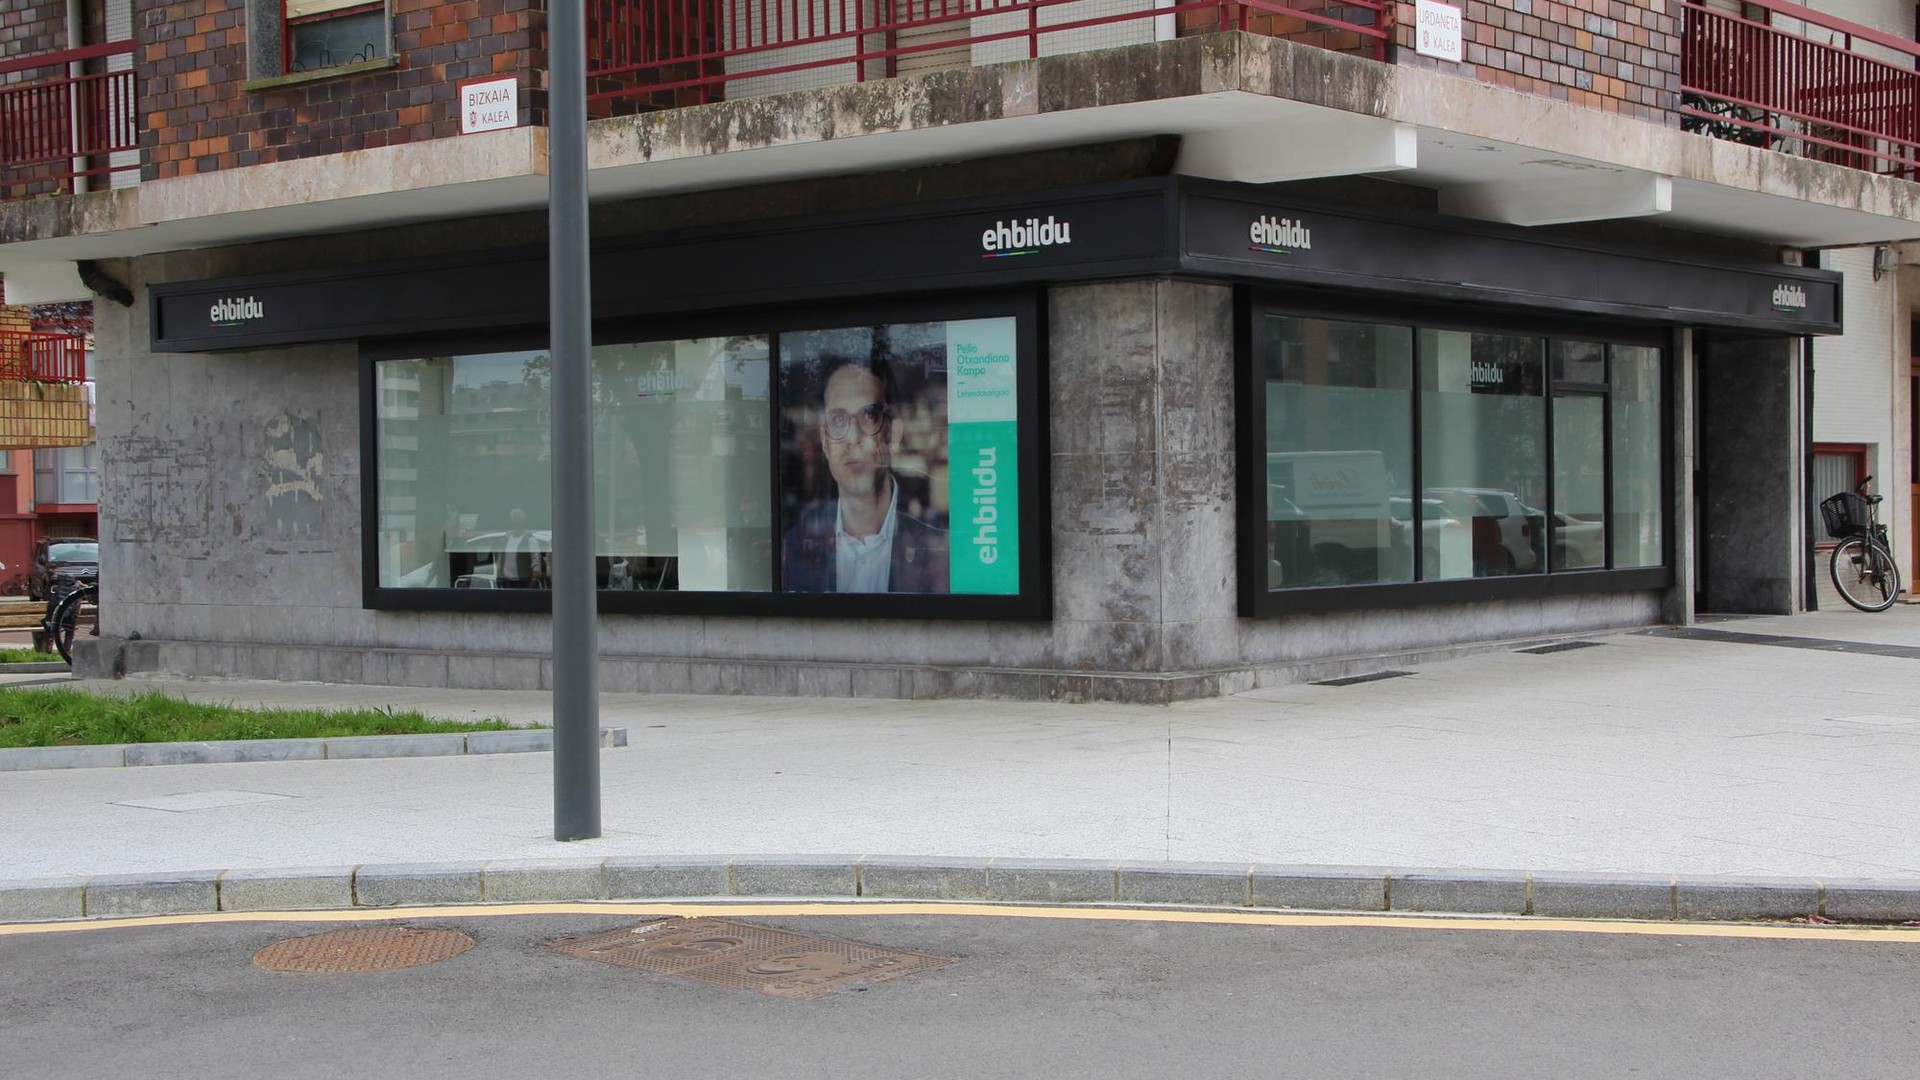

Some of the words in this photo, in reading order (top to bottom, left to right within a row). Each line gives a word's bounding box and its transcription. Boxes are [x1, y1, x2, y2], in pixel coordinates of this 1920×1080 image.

[1420, 8, 1459, 32] URDANETA
[1433, 36, 1456, 53] KALEA
[469, 88, 510, 107] BIZKAIA
[482, 110, 510, 124] KALEA
[982, 215, 1071, 251] ehbildu
[1250, 215, 1311, 249] ehbildu
[1772, 284, 1806, 308] ehbildu
[210, 295, 264, 322] ehbildu
[957, 343, 977, 353] Pello
[957, 353, 1009, 365] Otxandiano
[957, 366, 986, 377] Kanpo
[972, 446, 998, 565] ehbildu
